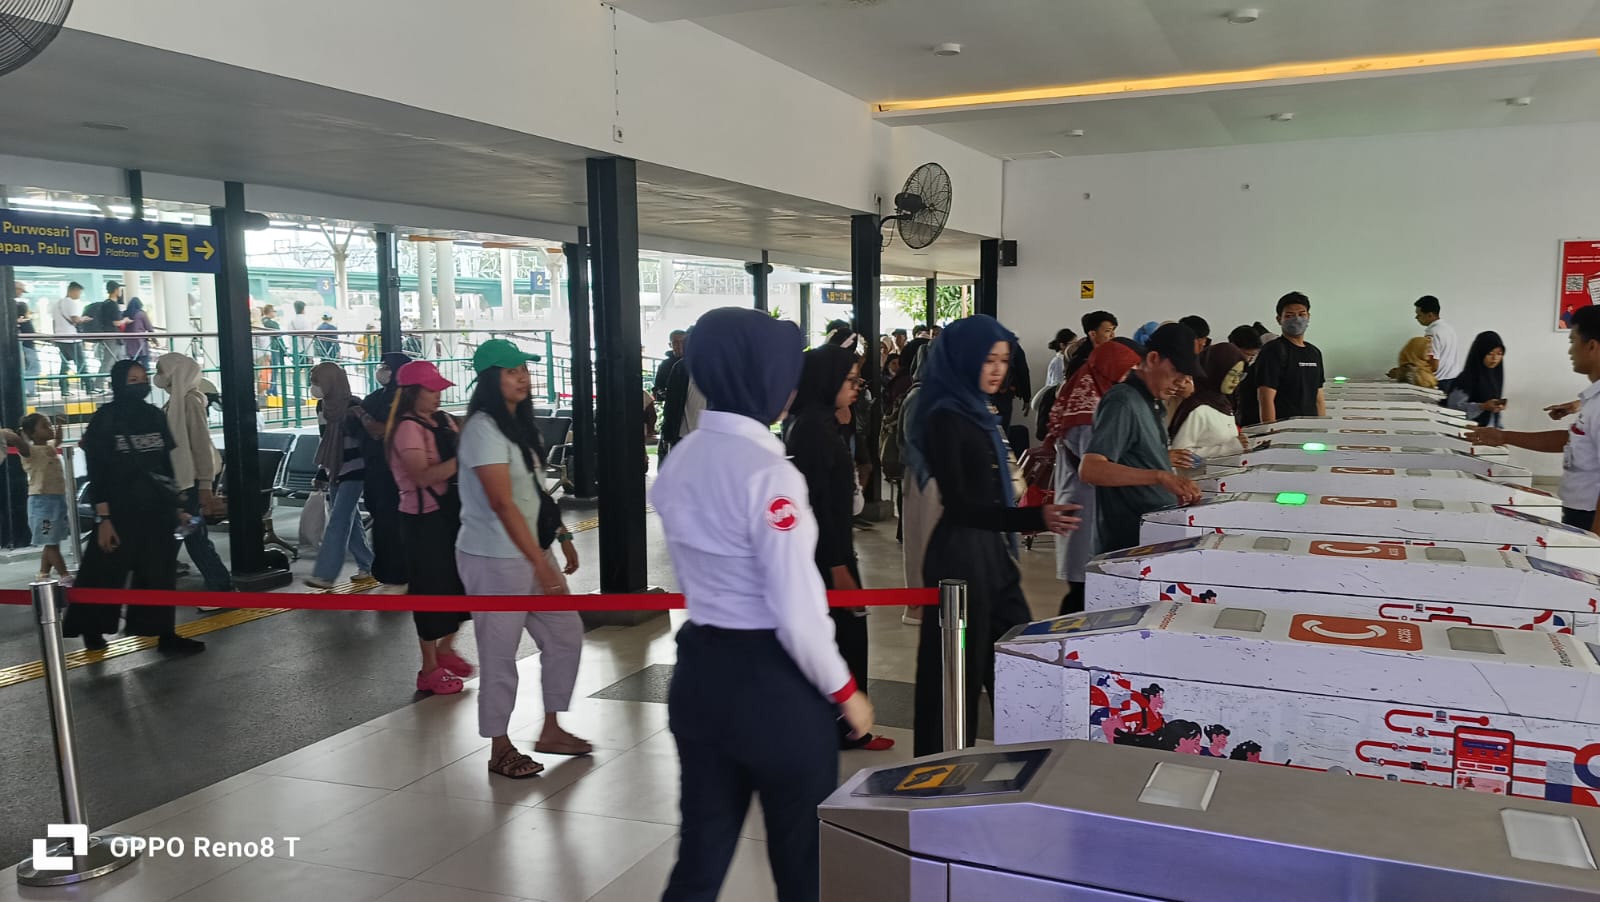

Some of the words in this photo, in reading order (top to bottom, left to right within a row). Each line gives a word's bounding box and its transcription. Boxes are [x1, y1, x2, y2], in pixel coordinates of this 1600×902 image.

[3, 221, 70, 238] Purwosari
[83, 236, 91, 248] Y
[104, 232, 139, 246] Peron
[38, 242, 71, 256] Palur
[105, 248, 139, 258] Platform
[142, 234, 160, 259] 3
[536, 274, 543, 286] 2
